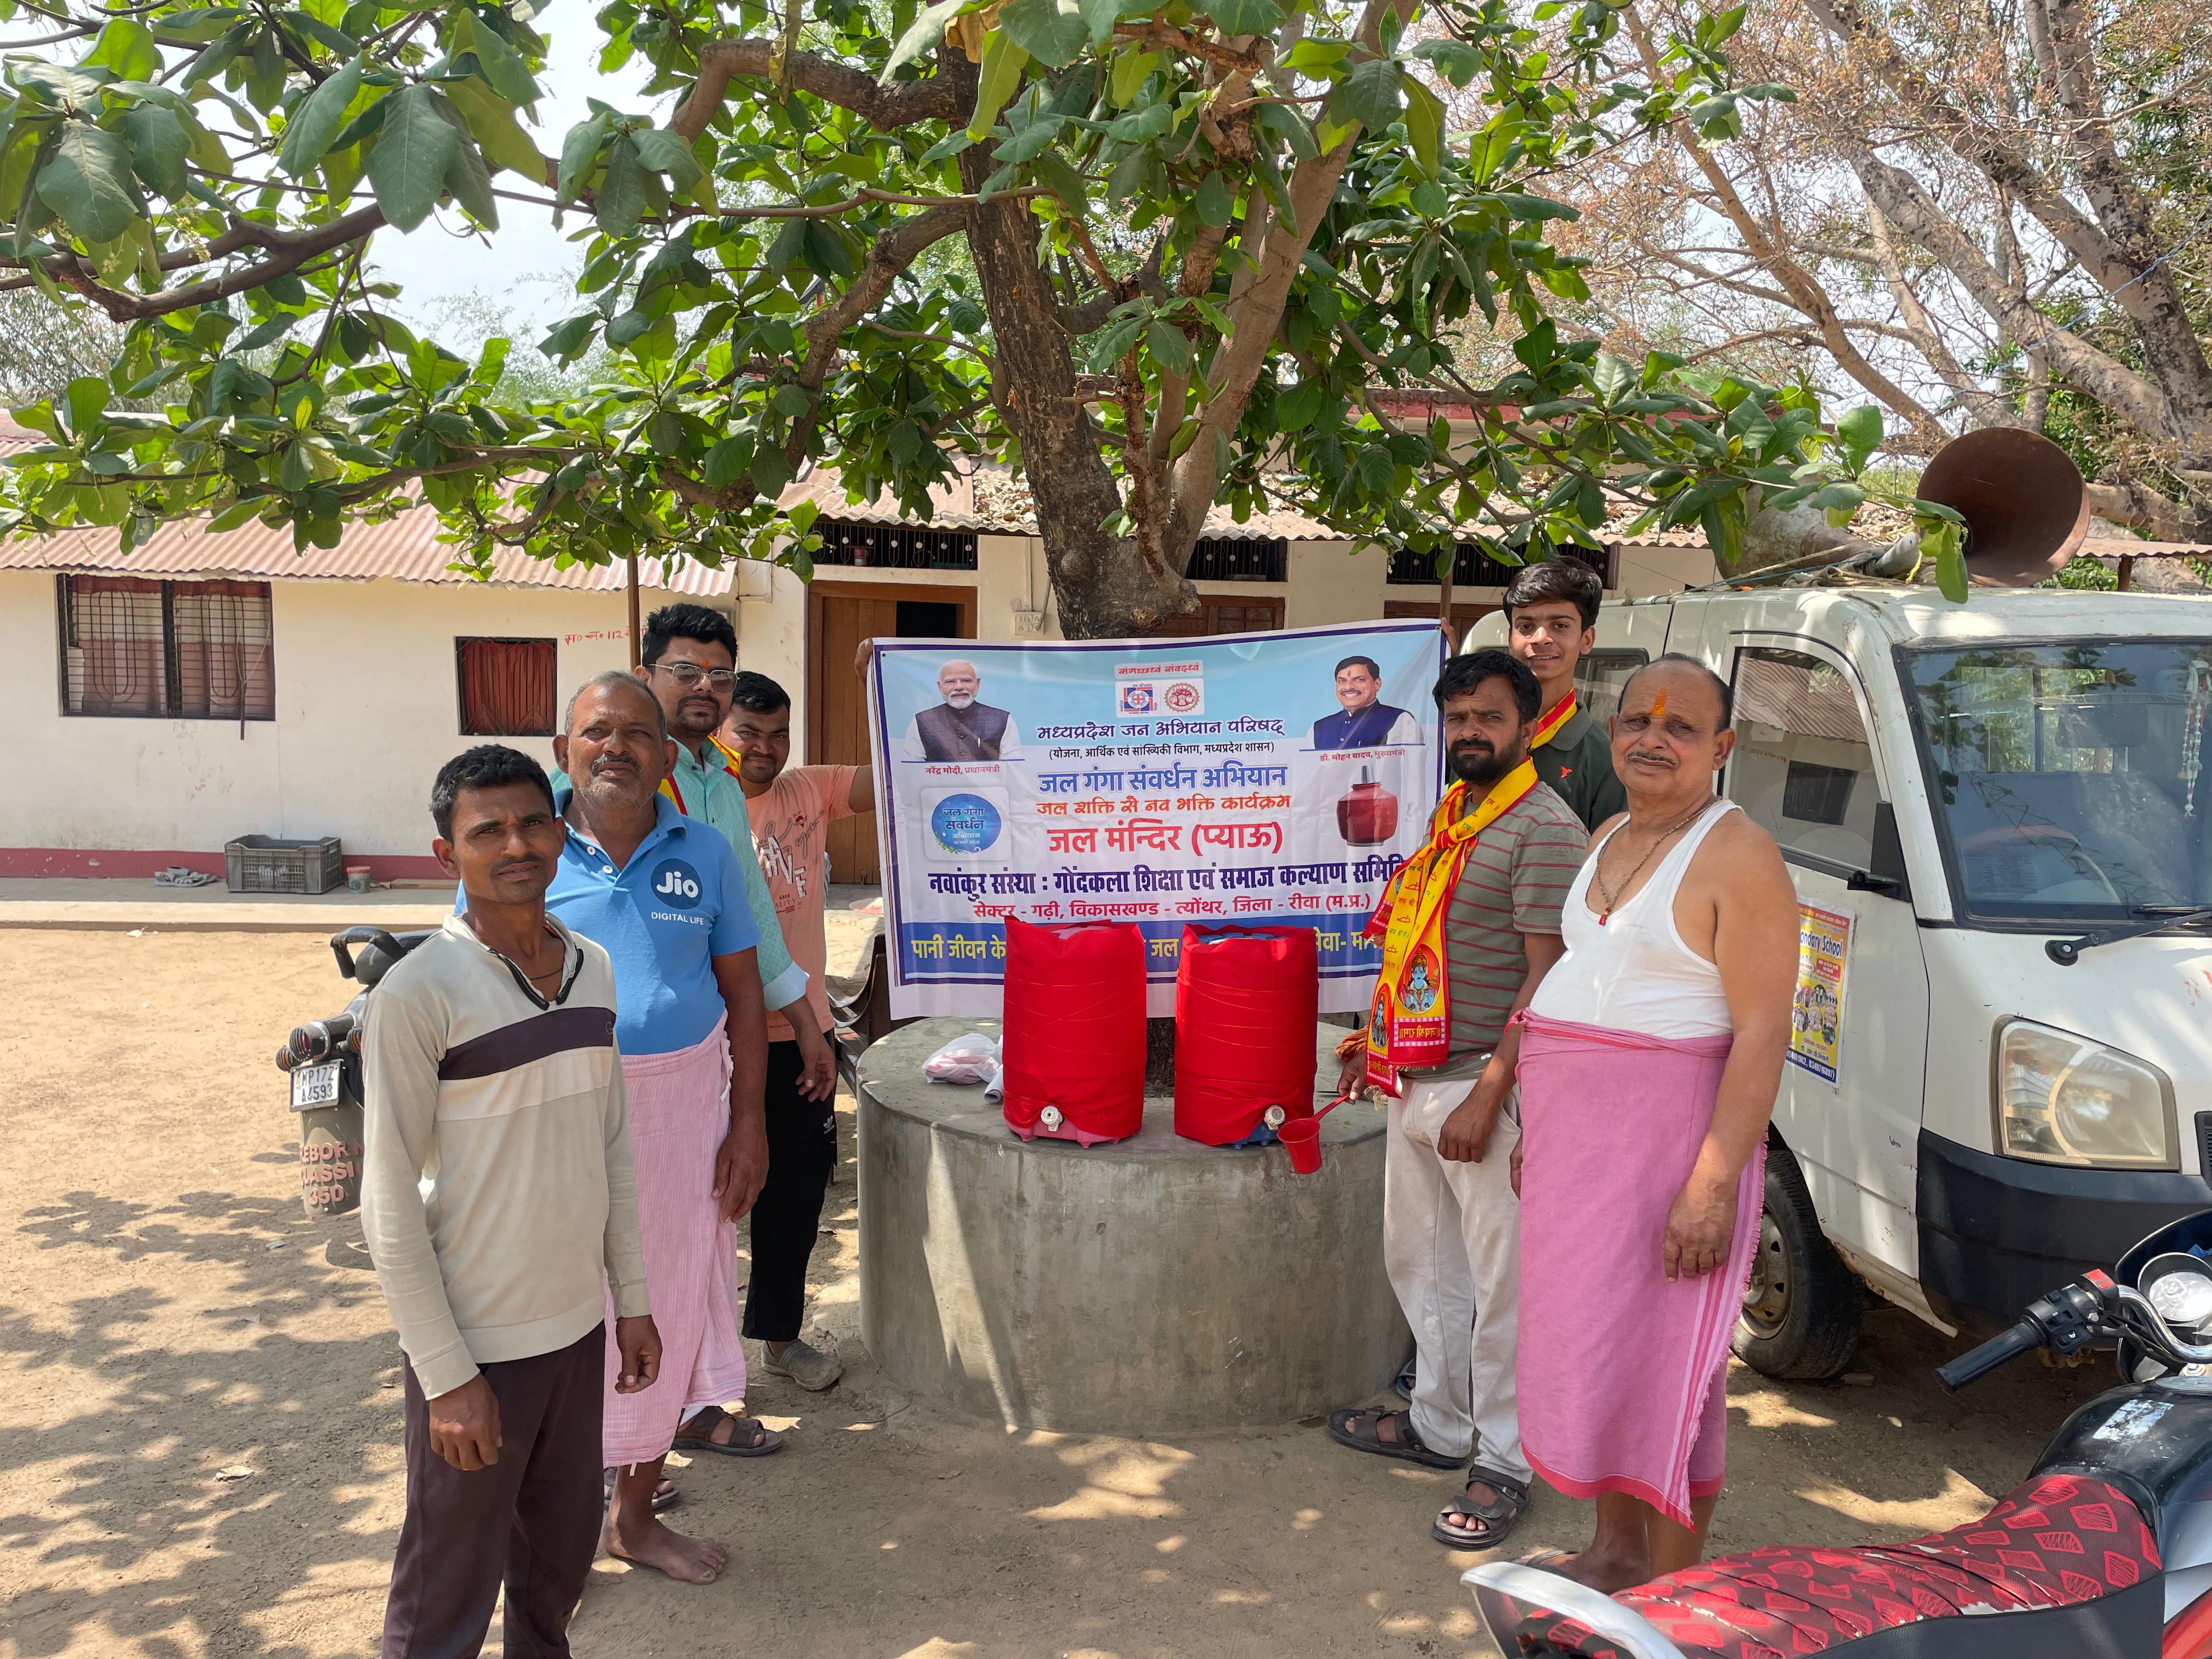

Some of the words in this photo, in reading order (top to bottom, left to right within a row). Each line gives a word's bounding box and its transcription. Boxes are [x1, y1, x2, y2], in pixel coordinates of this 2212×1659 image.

[608, 631, 623, 640] 112
[1037, 721, 1115, 740] मध्यप्रदेश
[1120, 724, 1150, 737] जन
[1155, 718, 1222, 737] अभियान
[1228, 716, 1286, 736] परिषद्
[1049, 746, 1083, 760] (योजना,
[1085, 744, 1115, 757] आर्थिक
[1118, 744, 1130, 757] एवं
[1132, 743, 1172, 757] सांख्यिकी
[1174, 743, 1203, 756] विभाग,
[1204, 742, 1242, 755] मध्यप्रदेश
[1245, 741, 1274, 753] शासन)
[1319, 753, 1330, 761] डॉ.
[1332, 752, 1351, 761] मोहन
[1374, 748, 1405, 759] मुख्यमंत्री
[925, 766, 941, 775] नरेंद्र
[943, 765, 963, 775] मोदी,
[964, 764, 1000, 775] प्रधानमंत्री
[1038, 772, 1079, 793] जल
[1083, 765, 1125, 792] गंगा
[1128, 761, 1197, 790] संवर्धन
[1203, 760, 1288, 788] अभियान
[964, 805, 984, 816] गंगा
[1036, 803, 1068, 815] जल
[1074, 797, 1116, 814] शक्ति
[1120, 795, 1139, 813] से
[1144, 799, 1170, 812] नव
[1176, 793, 1215, 811] भक्ति
[1220, 792, 1291, 809] कार्यक्रम
[945, 816, 985, 830] संवर्धन
[1047, 827, 1098, 853] जल
[1191, 822, 1283, 856] (प्याऊ)
[656, 871, 699, 898] Jio
[928, 867, 986, 901] नवांकुर
[990, 866, 1036, 894] संस्था
[1053, 865, 1130, 893] गोंदकला
[1133, 864, 1183, 893] शिक्षा
[1187, 862, 1217, 890] एवं
[1219, 866, 1275, 890] समाज
[1278, 862, 1348, 887] कल्याण
[973, 901, 1016, 918] सेक्टर
[1070, 900, 1160, 917] विकासखण्ड
[1175, 897, 1228, 915] त्योंथर,
[1233, 895, 1273, 913] जिला
[1288, 893, 1320, 910] रीवा
[1325, 893, 1370, 912] (म.प्र.)
[651, 911, 688, 923] DIGITAL
[690, 916, 704, 926] LIFE
[911, 934, 944, 959] पानी
[947, 934, 987, 960] जीवन
[1149, 939, 1179, 957] जल
[1800, 930, 1821, 953] ondary
[1822, 935, 1843, 957] School
[309, 1184, 345, 1206] 350
